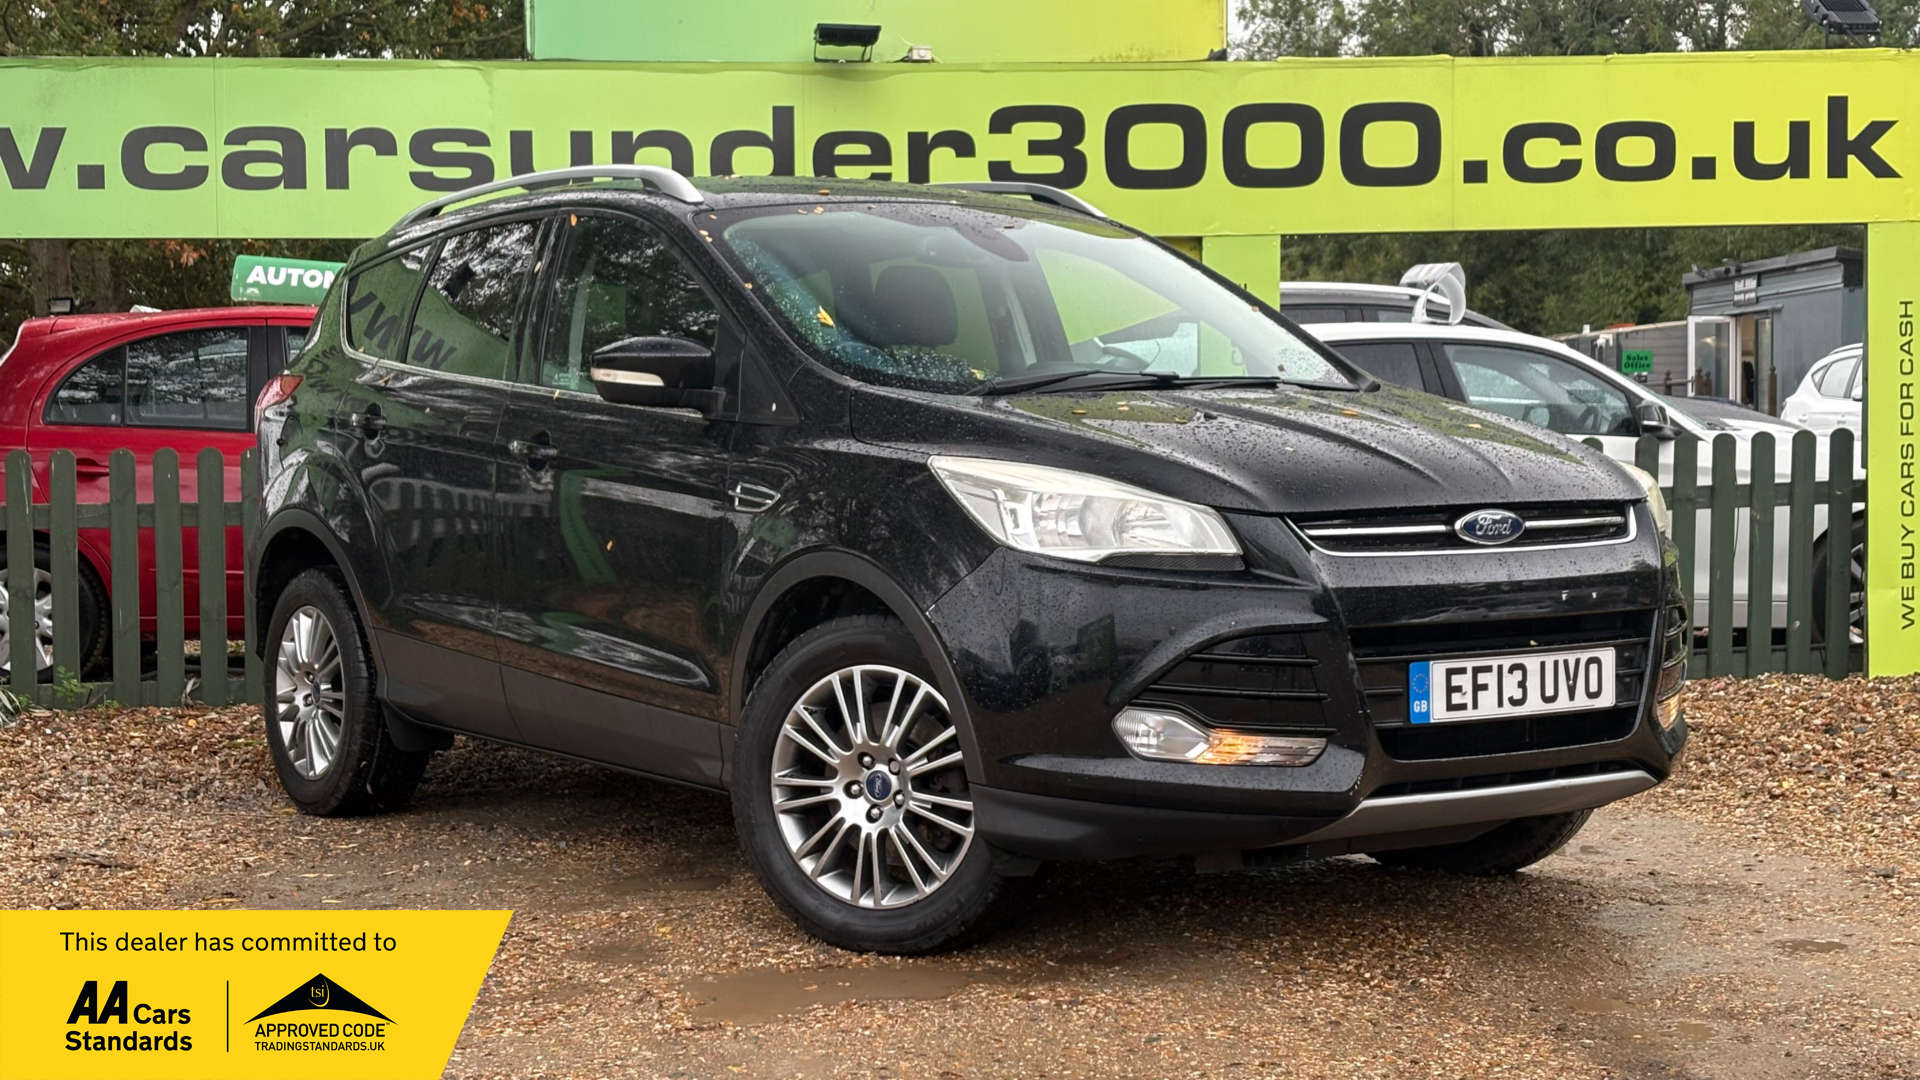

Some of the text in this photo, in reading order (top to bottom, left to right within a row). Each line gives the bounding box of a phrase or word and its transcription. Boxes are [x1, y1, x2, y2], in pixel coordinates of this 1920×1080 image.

[1899, 300, 1915, 630] WE BUY CARS FOR CASH
[1475, 514, 1512, 536] Ford
[1445, 656, 1602, 712] EF13 UVO
[1413, 700, 1427, 713] GB
